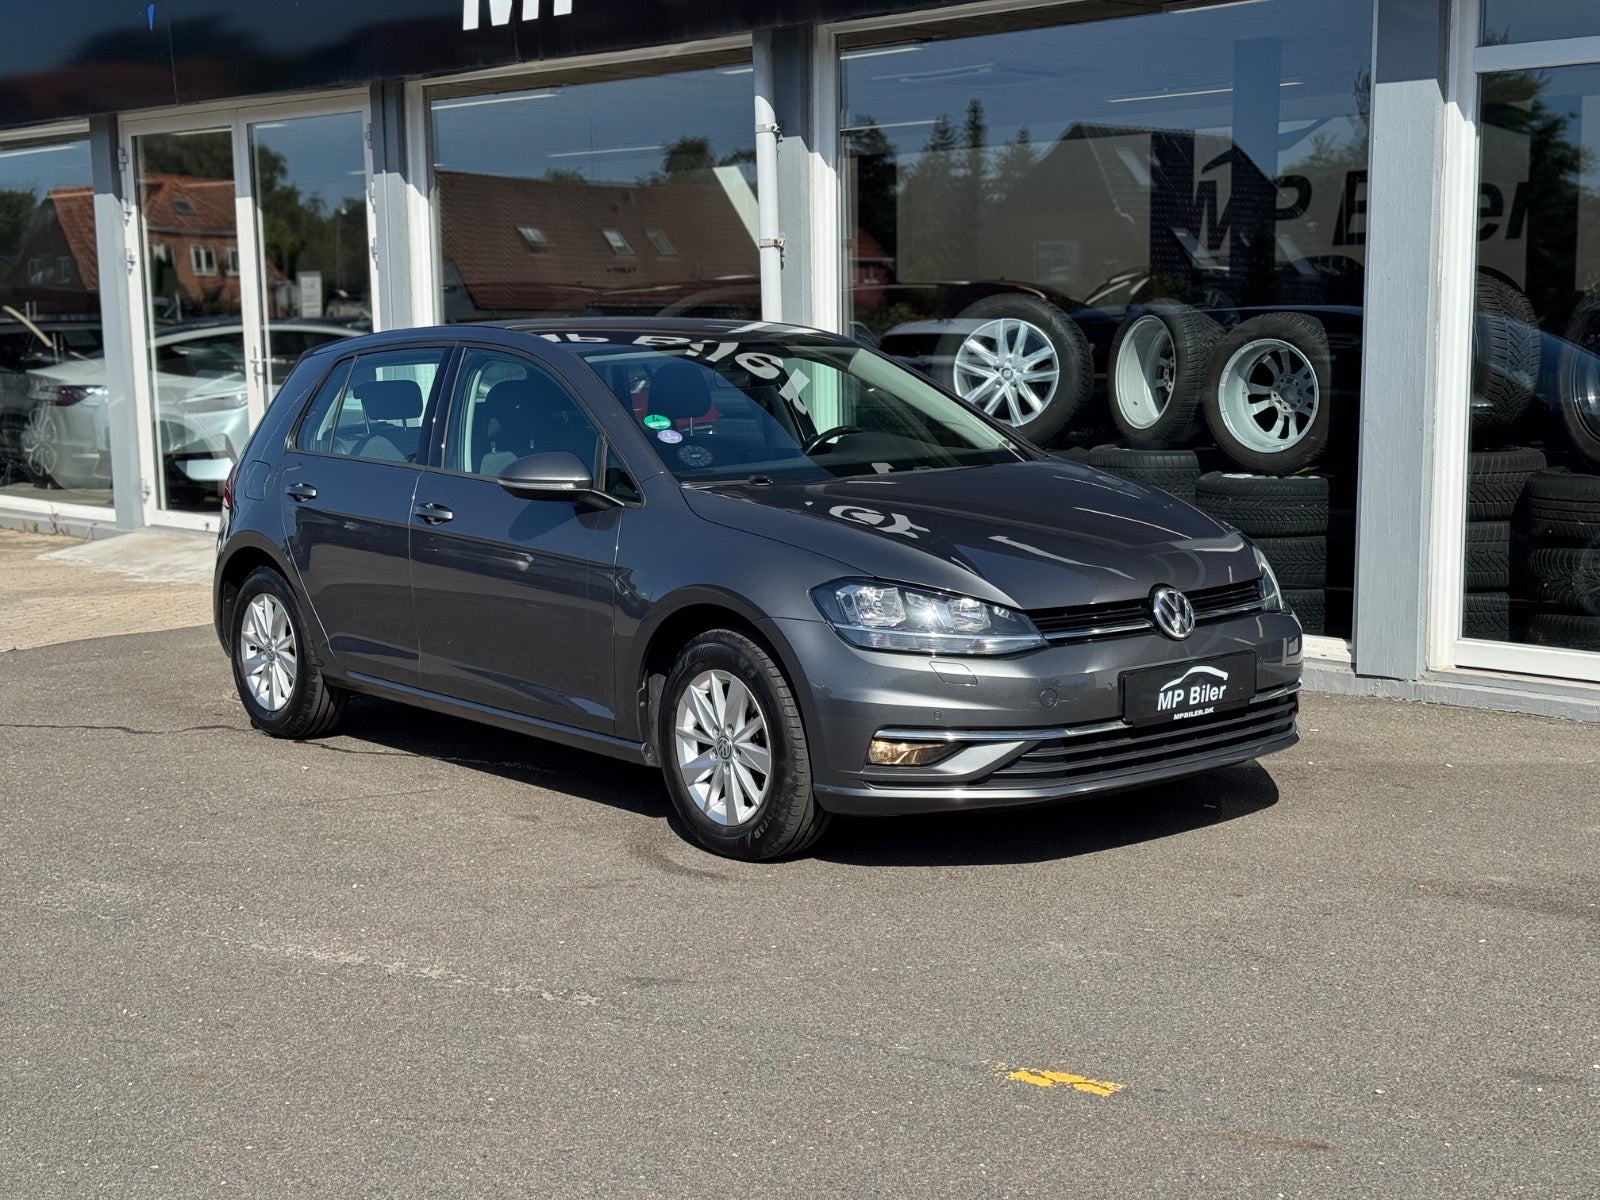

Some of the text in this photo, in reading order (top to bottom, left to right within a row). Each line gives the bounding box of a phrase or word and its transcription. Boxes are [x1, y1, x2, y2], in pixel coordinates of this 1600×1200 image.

[1157, 684, 1227, 711] MP Biler
[1173, 707, 1214, 720] MPBILER.DK
